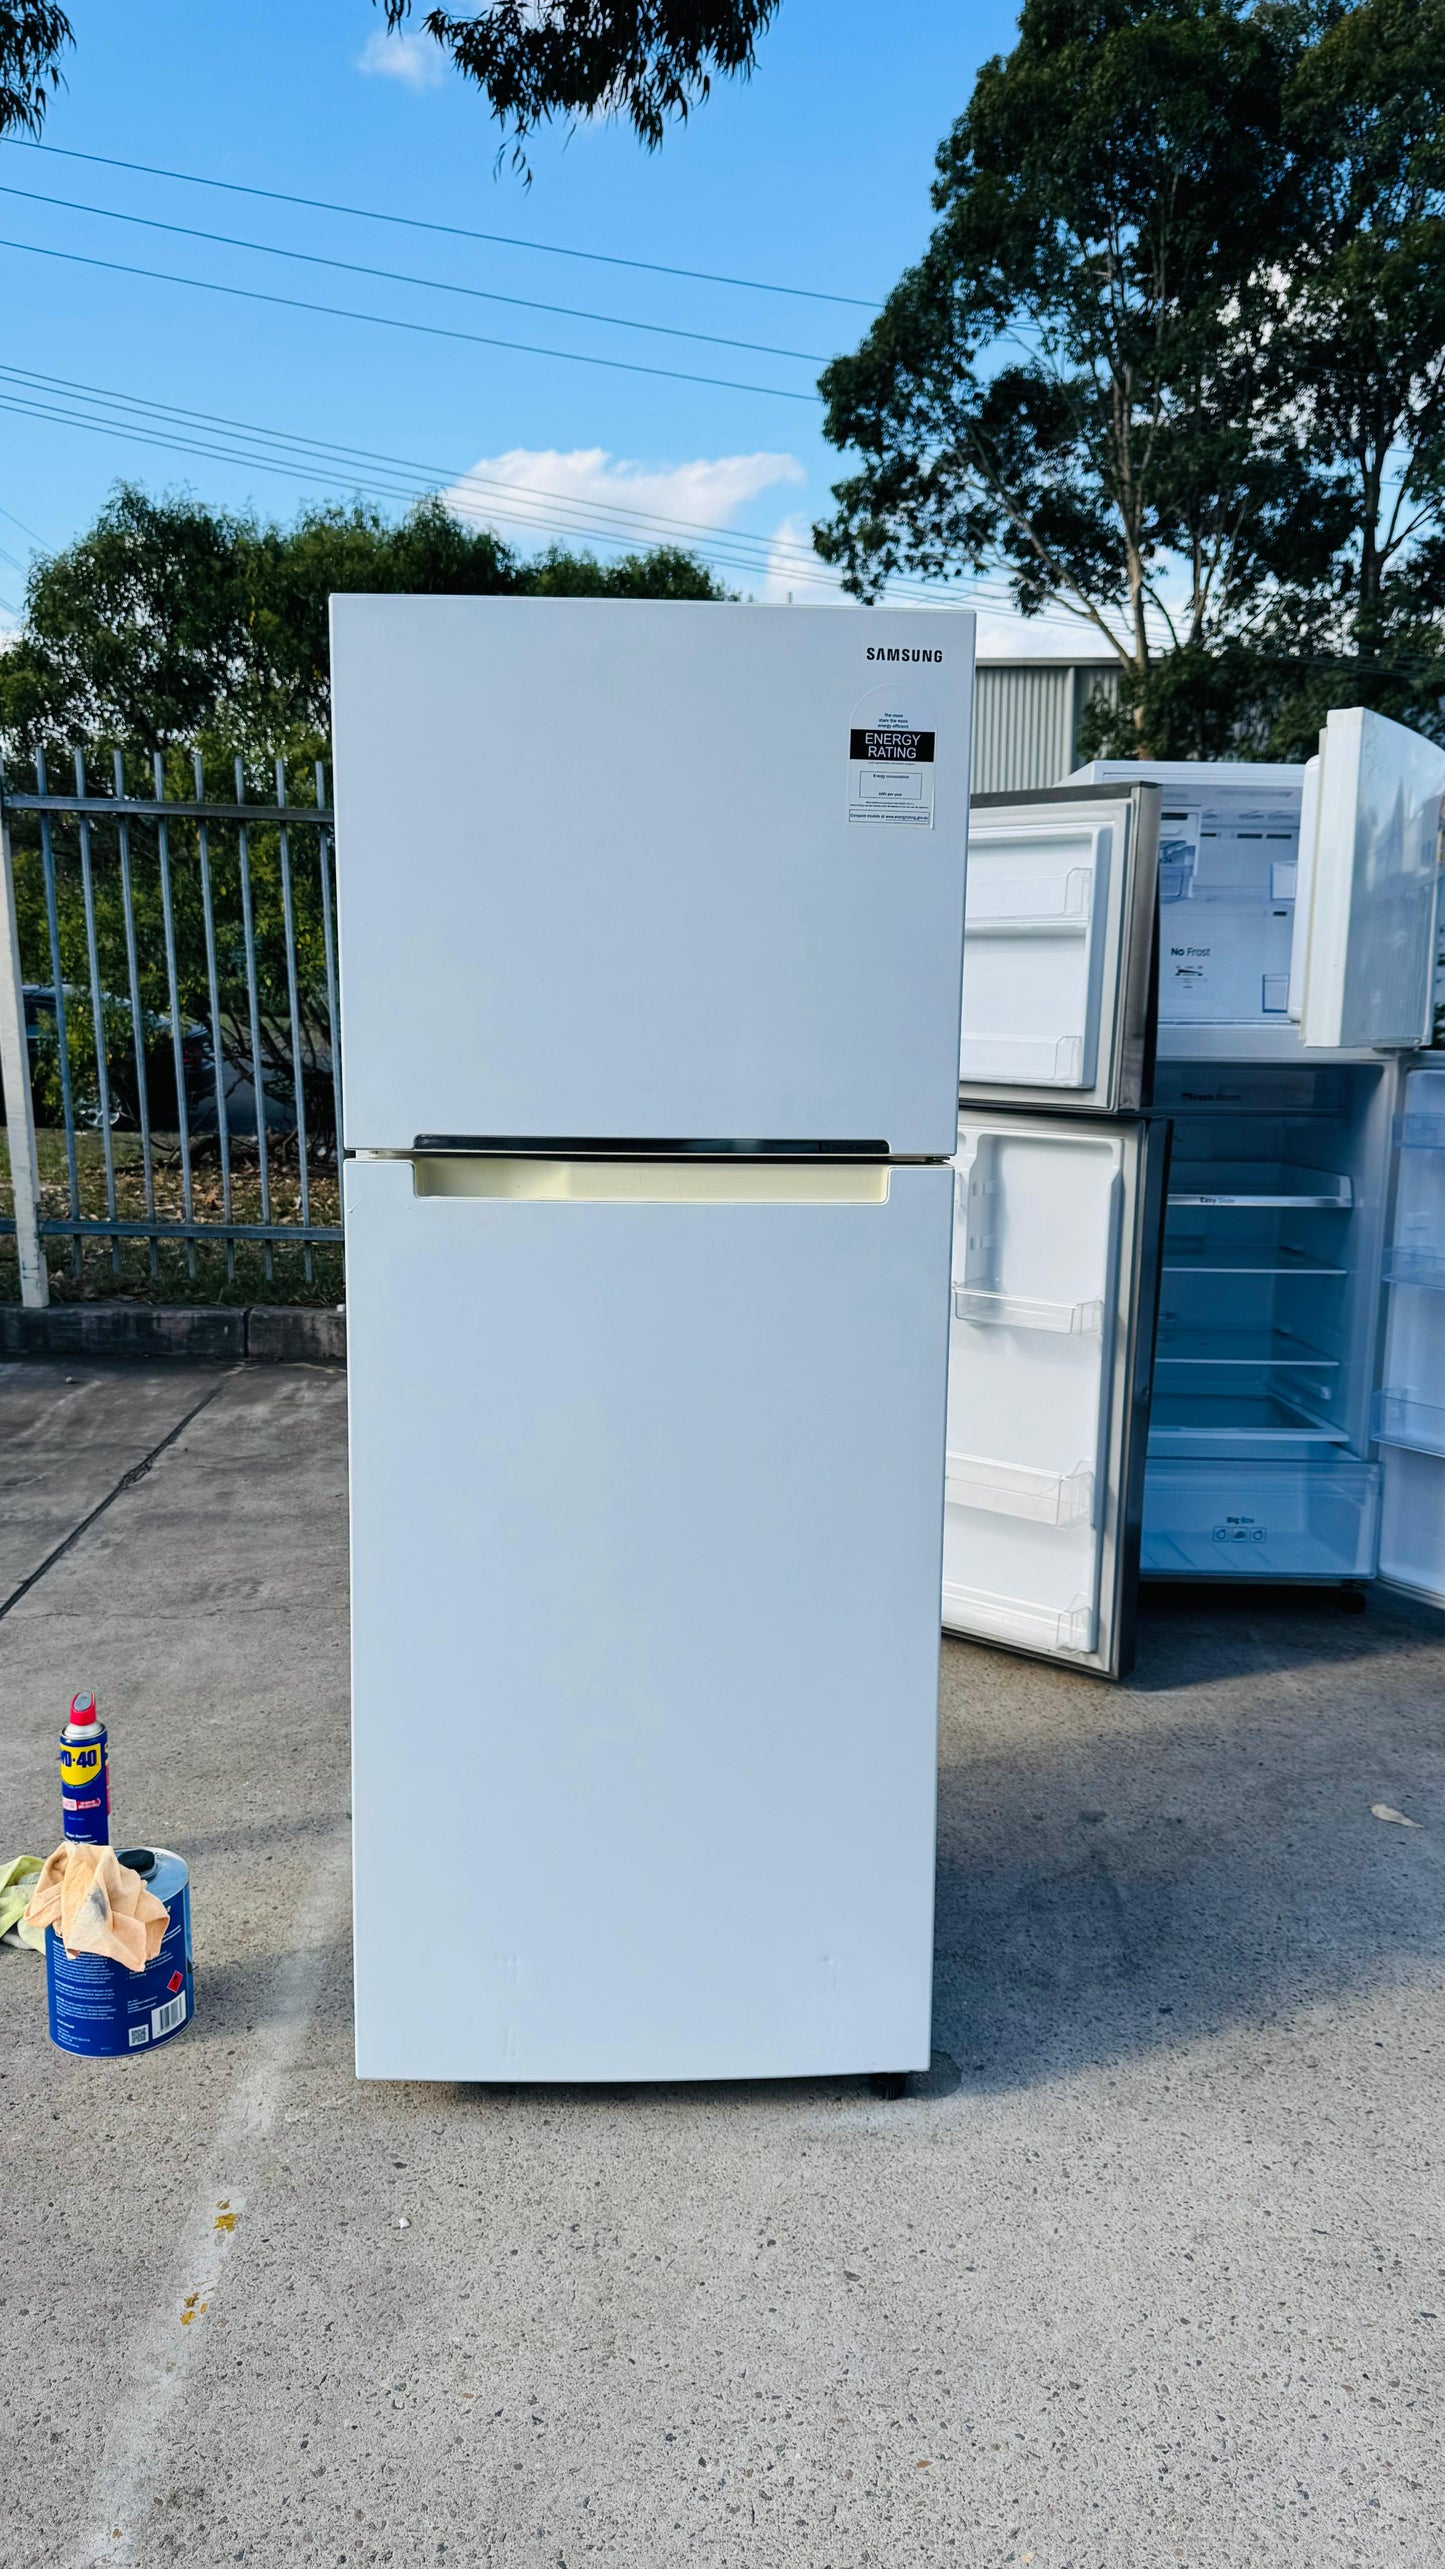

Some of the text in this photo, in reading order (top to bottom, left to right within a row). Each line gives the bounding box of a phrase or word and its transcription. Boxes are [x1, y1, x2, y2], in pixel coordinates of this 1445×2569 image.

[866, 647, 943, 663] SAMSUNG
[865, 732, 921, 746] ENERGY
[868, 745, 917, 759] RATING
[1171, 947, 1211, 957] No Frost
